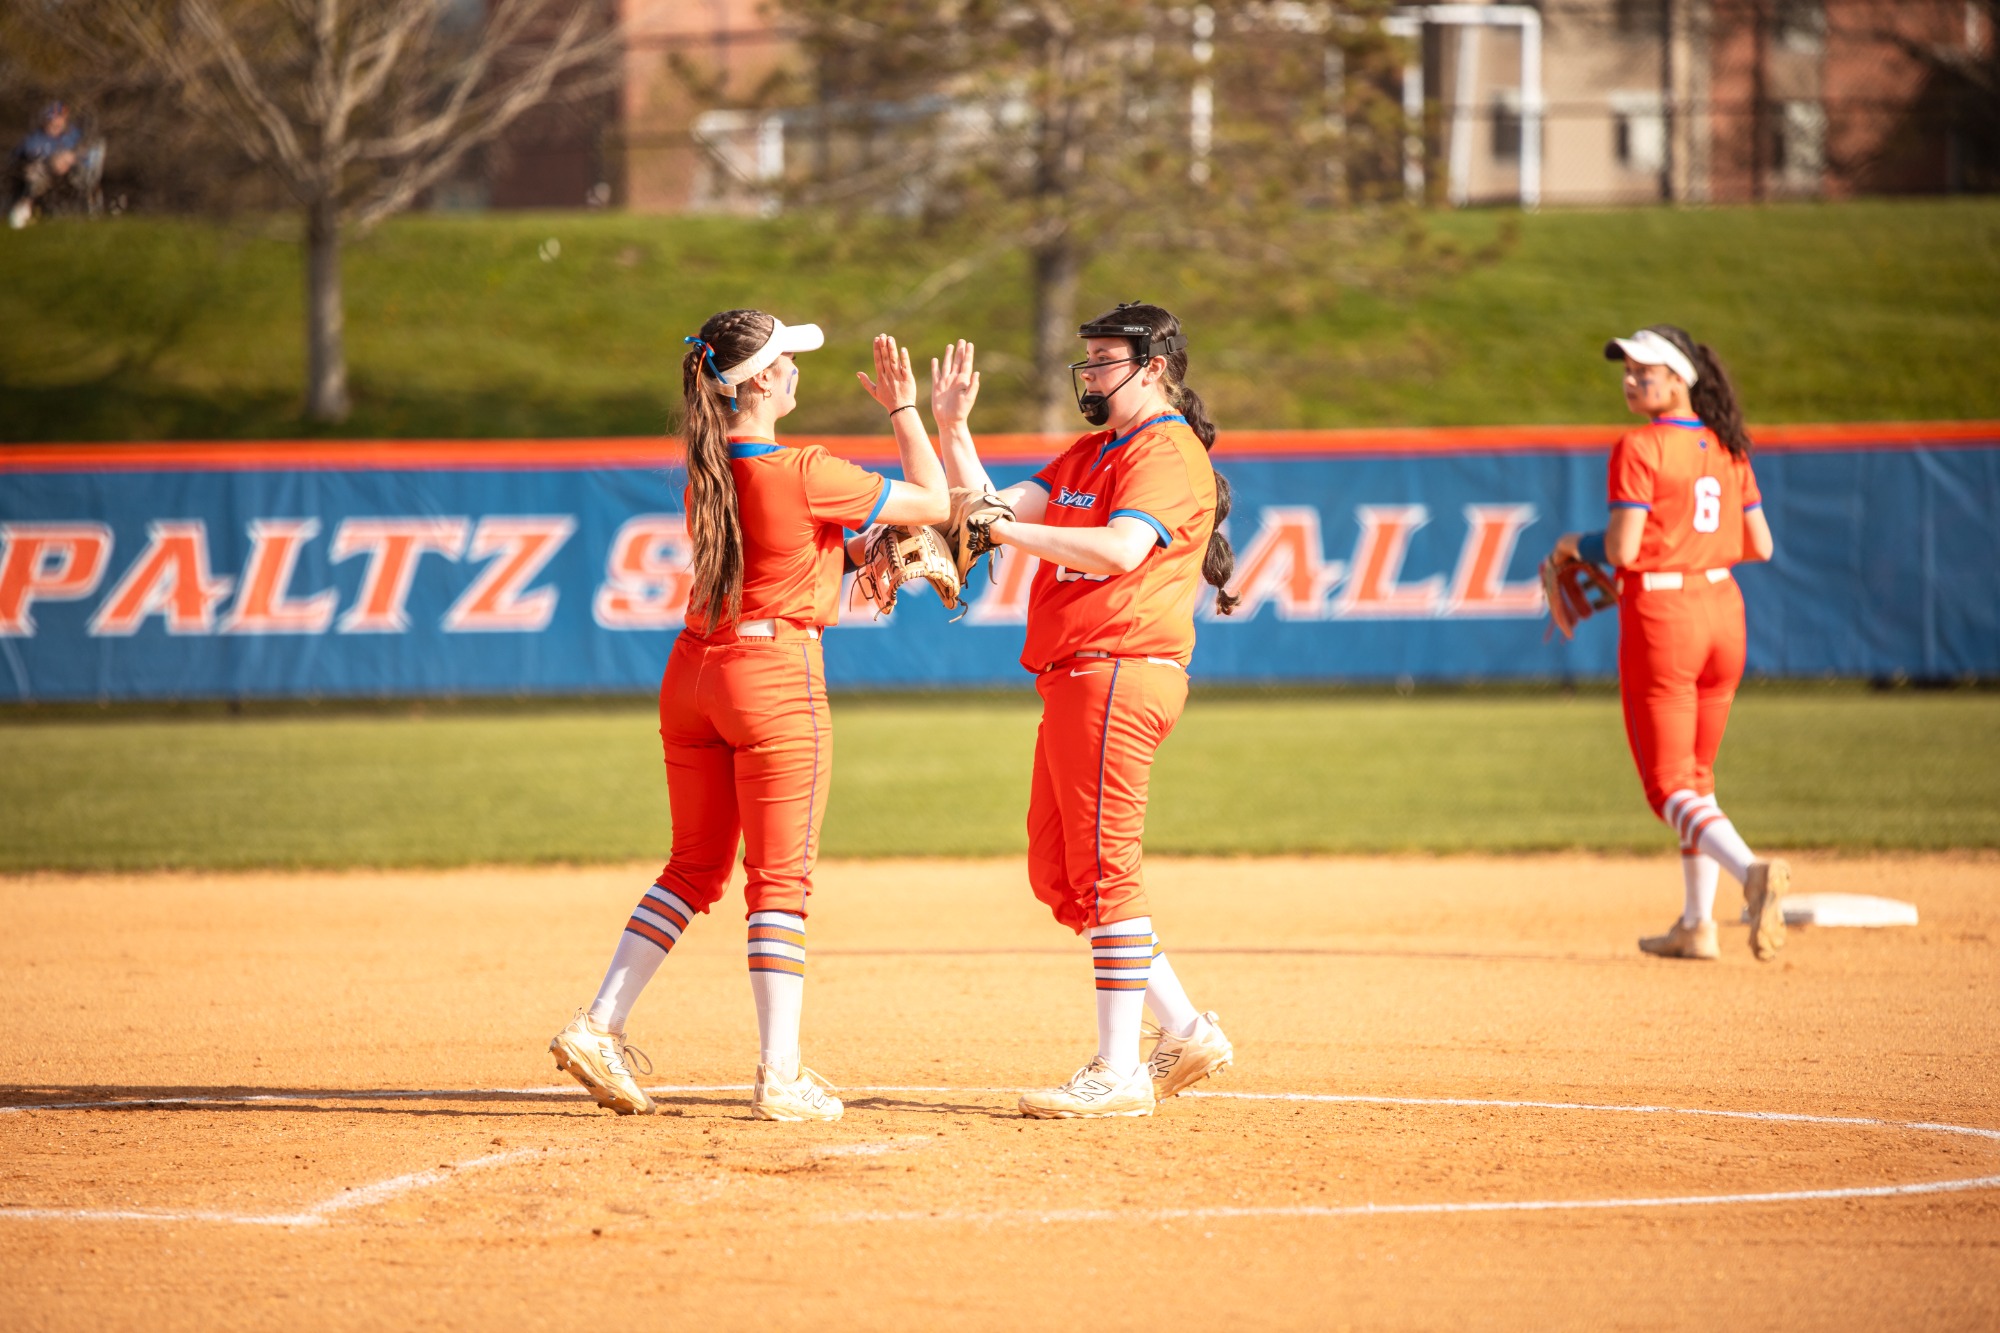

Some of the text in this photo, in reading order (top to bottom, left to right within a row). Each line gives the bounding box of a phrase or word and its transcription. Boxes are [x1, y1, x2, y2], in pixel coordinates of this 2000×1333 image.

[1693, 476, 1721, 533] 6
[0, 503, 1547, 637] PALTZ SALL
